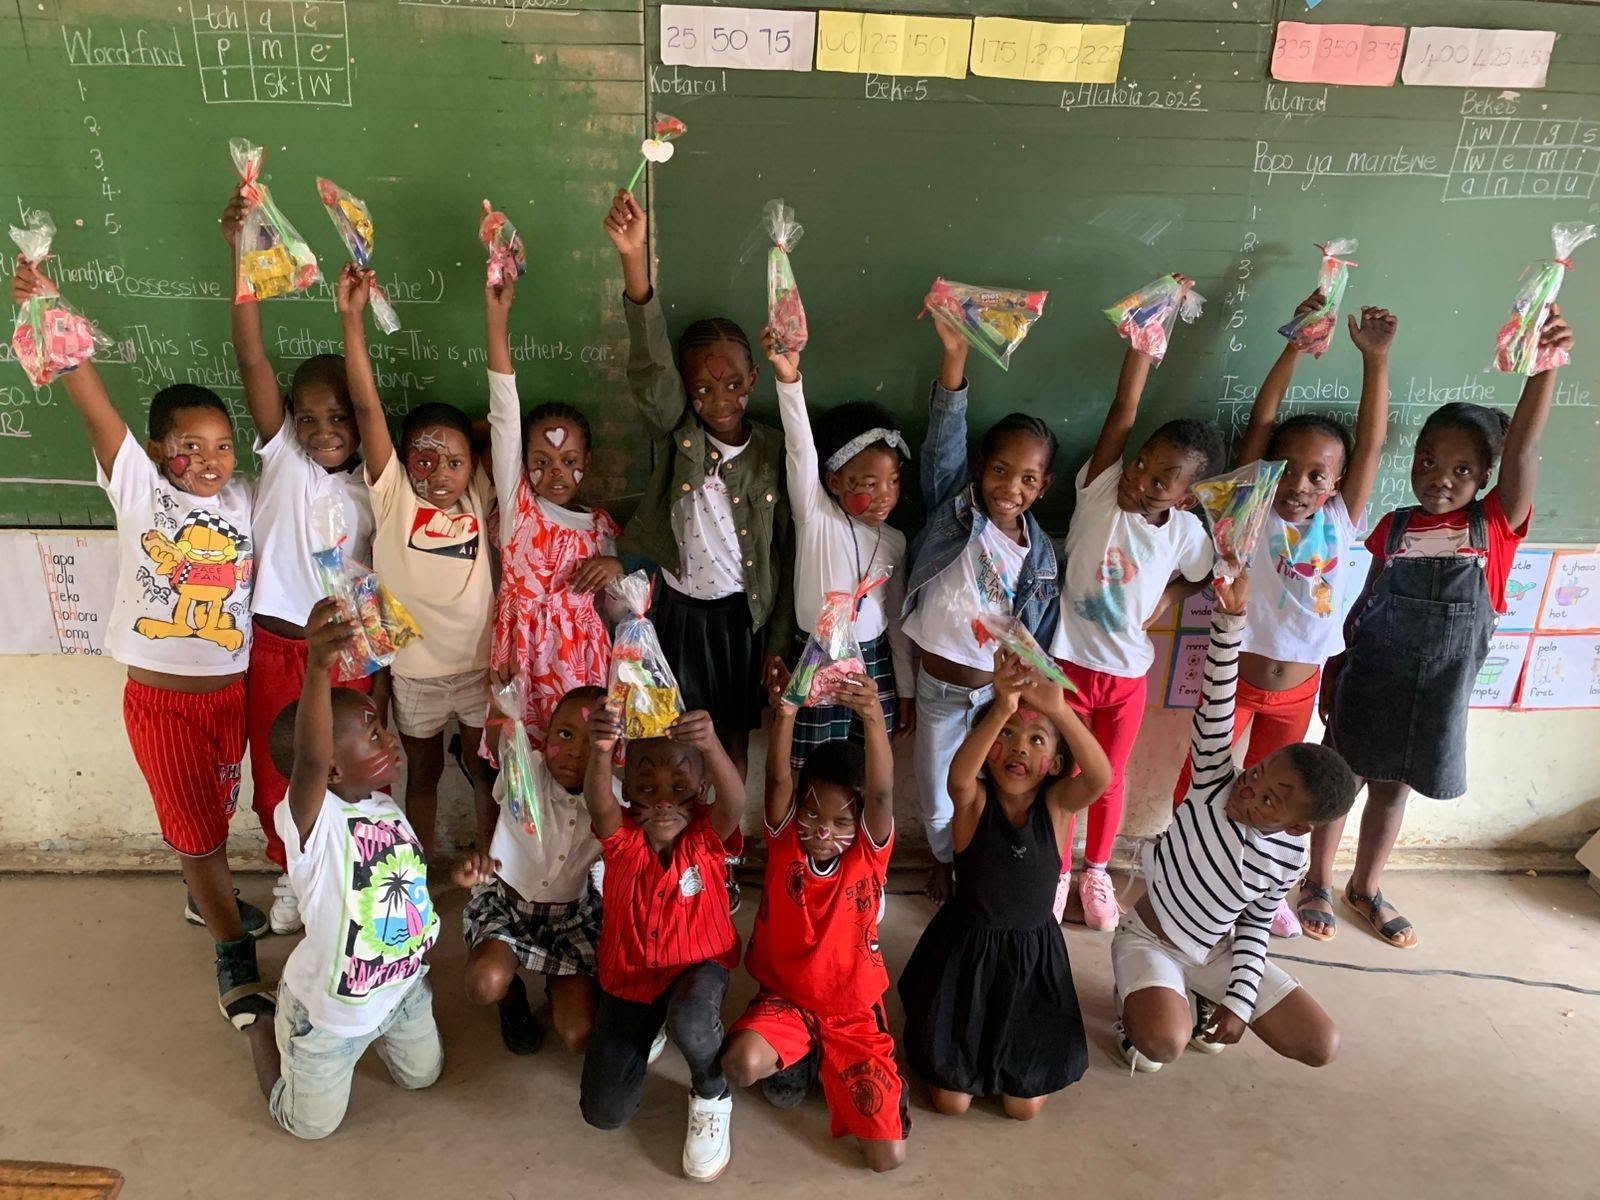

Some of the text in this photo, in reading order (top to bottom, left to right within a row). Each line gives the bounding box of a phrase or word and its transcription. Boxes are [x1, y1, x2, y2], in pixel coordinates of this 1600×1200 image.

[205, 4, 239, 29] tch
[262, 38, 283, 59] m
[310, 41, 328, 62] e
[667, 26, 791, 56] 25 50 75
[819, 30, 860, 55] 100
[980, 38, 1017, 64] 175
[1275, 38, 1311, 60] 325
[1319, 38, 1358, 59] 350
[1253, 141, 1294, 186] Popo
[1302, 154, 1333, 191] ya
[1502, 153, 1514, 169] e
[1537, 150, 1557, 170] m
[1461, 176, 1579, 195] a n o u
[123, 324, 180, 356] This
[188, 333, 209, 357] is
[448, 341, 459, 361] is
[459, 546, 477, 555] AI
[1190, 605, 1212, 616] wide
[1549, 608, 1568, 618] hot
[1179, 684, 1199, 695] few
[1472, 688, 1501, 700] mpty
